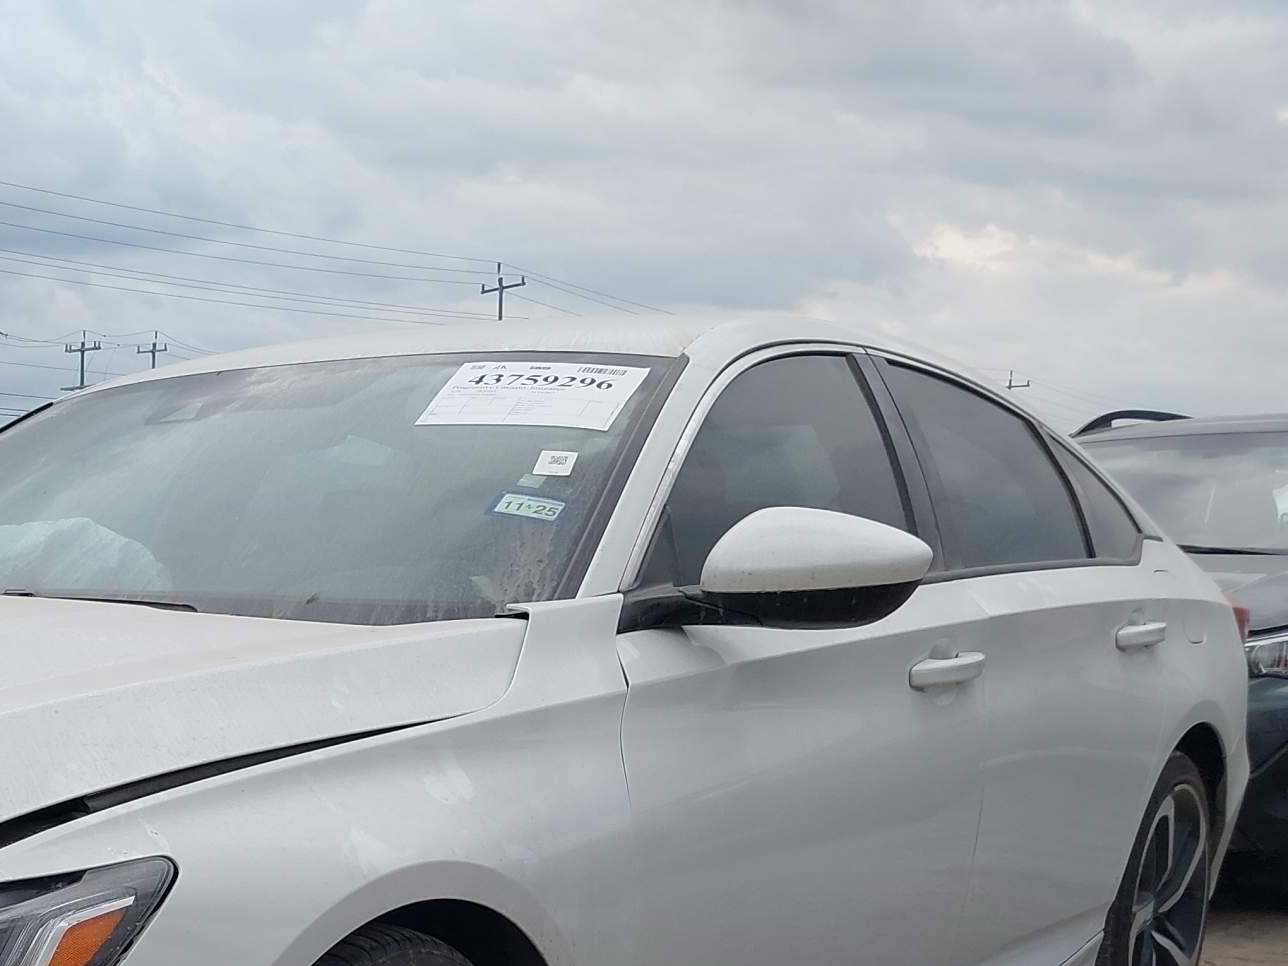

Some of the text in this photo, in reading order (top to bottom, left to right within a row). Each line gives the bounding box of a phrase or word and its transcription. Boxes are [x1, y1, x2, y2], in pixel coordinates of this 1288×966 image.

[468, 373, 615, 390] 43759296
[504, 501, 559, 517] 11 25
